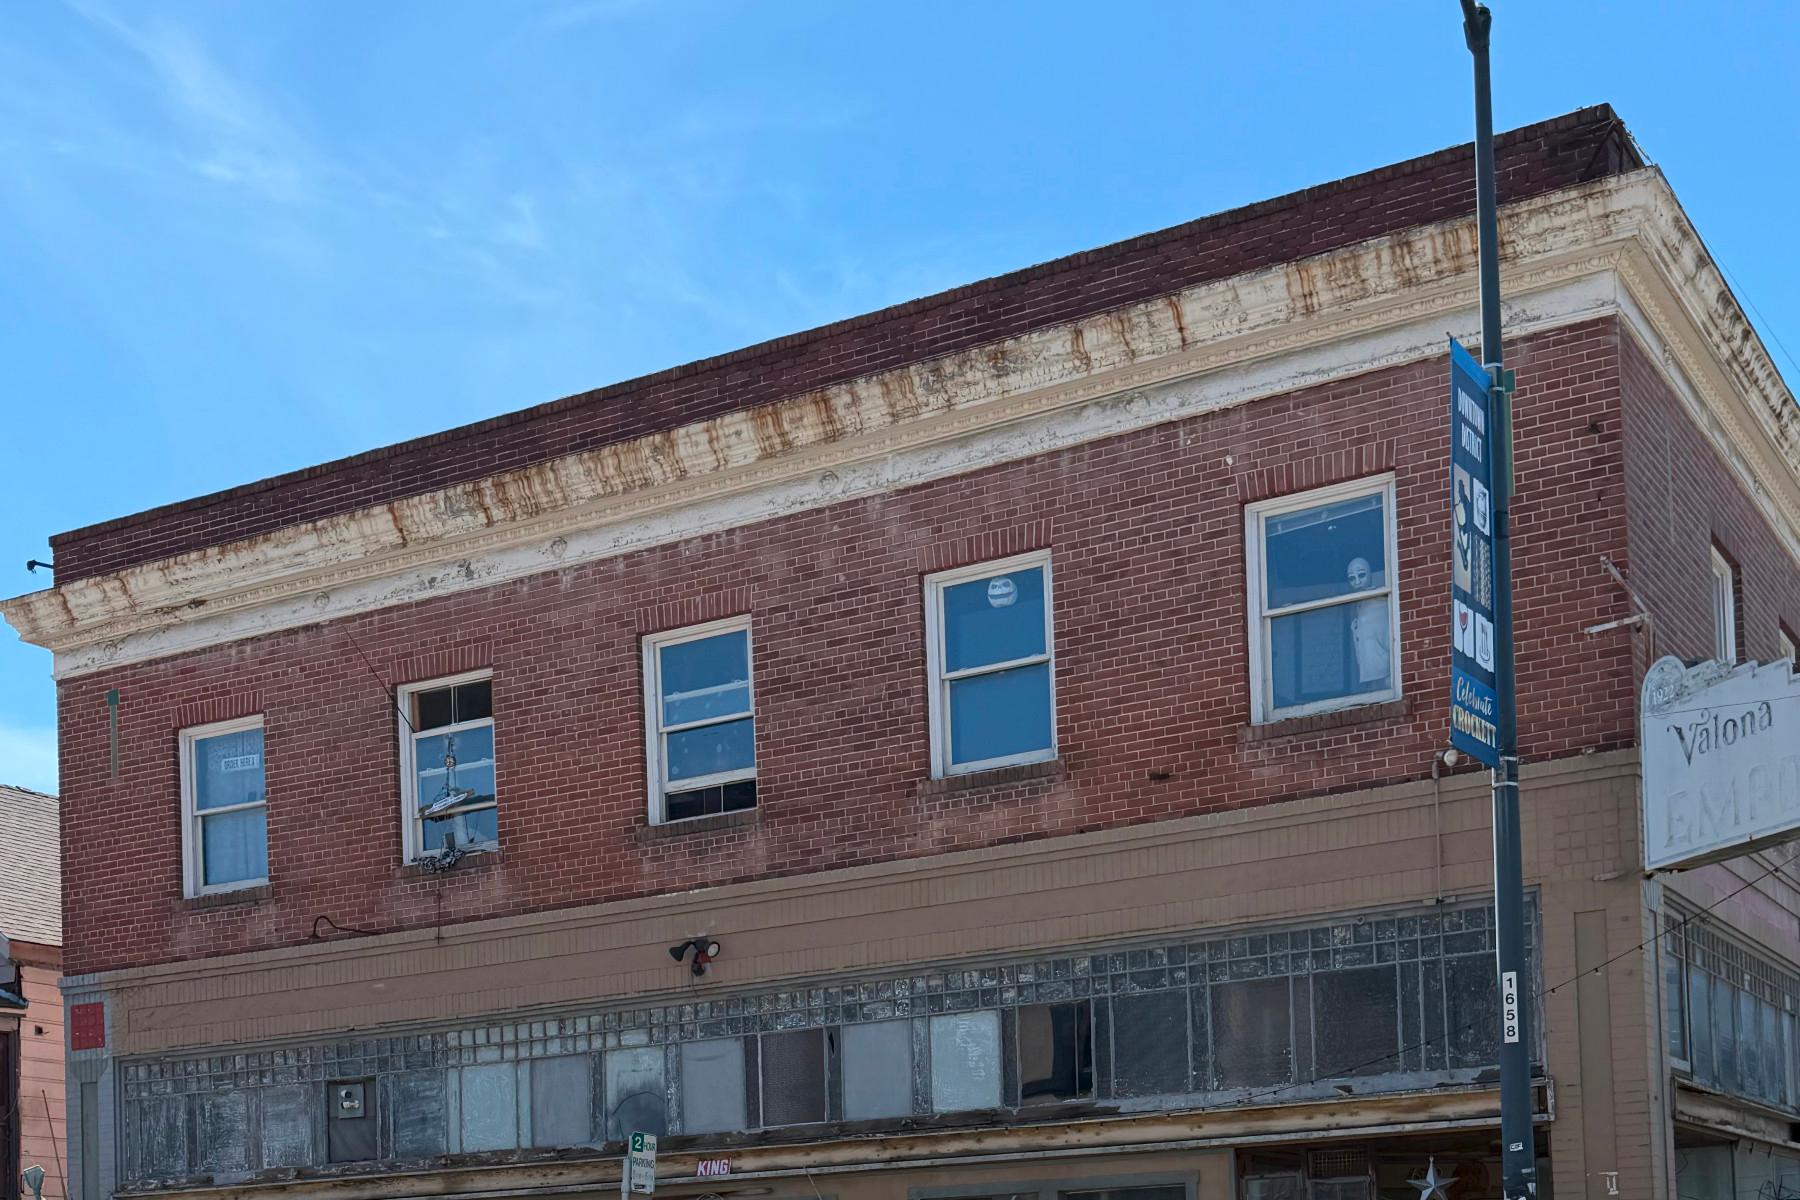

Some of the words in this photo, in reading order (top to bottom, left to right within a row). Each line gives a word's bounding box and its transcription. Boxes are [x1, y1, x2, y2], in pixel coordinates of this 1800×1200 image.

[1456, 676, 1493, 716] Celebrate
[1452, 704, 1497, 748] CROCKETT
[1667, 702, 1774, 767] Valona
[1505, 977, 1516, 1037] 1658
[632, 1156, 655, 1169] PARKING
[634, 1136, 642, 1149] 2
[644, 1142, 656, 1152] HOUR
[697, 1159, 729, 1176] KING
